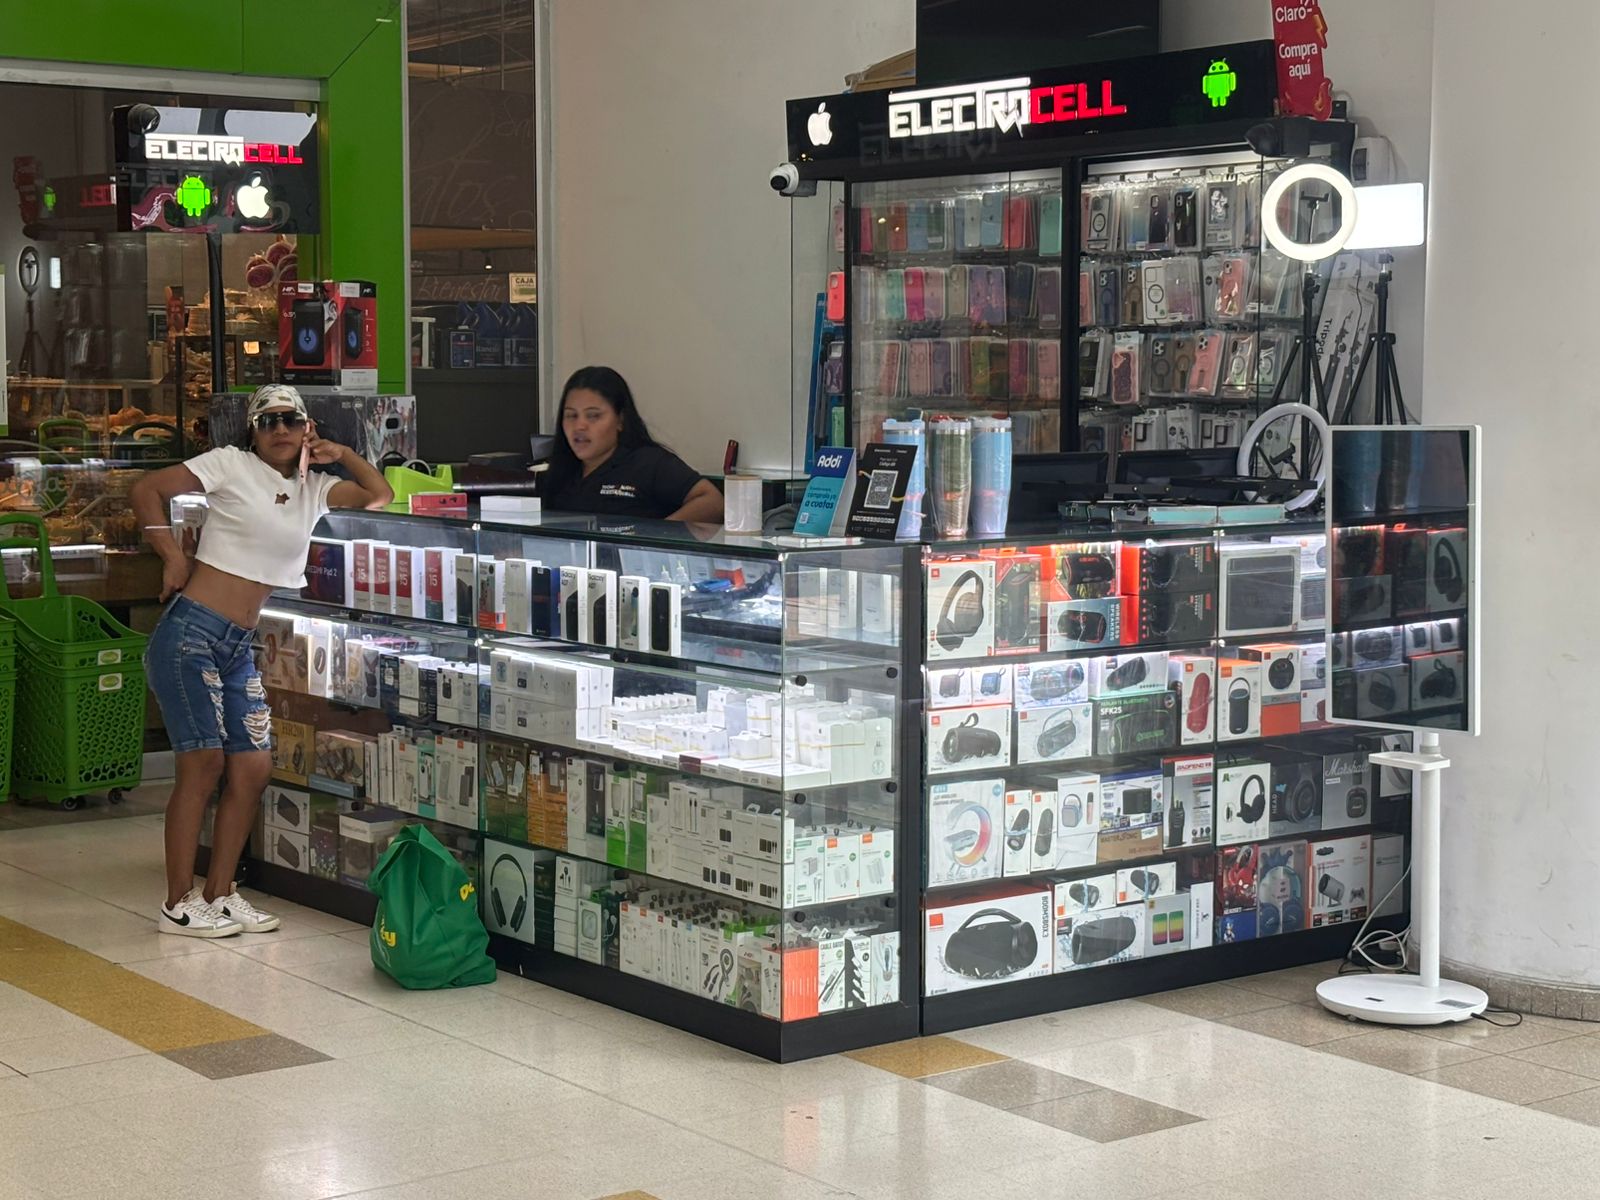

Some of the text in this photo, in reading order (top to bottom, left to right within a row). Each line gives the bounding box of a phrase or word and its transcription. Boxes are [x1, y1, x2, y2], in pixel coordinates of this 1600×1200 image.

[1278, 43, 1317, 64] Compra
[1288, 58, 1311, 80] aquí
[817, 455, 842, 469] Addi
[811, 501, 834, 509] cuotas
[357, 568, 367, 581] 15
[377, 571, 386, 583] 15
[429, 574, 438, 586] 15
